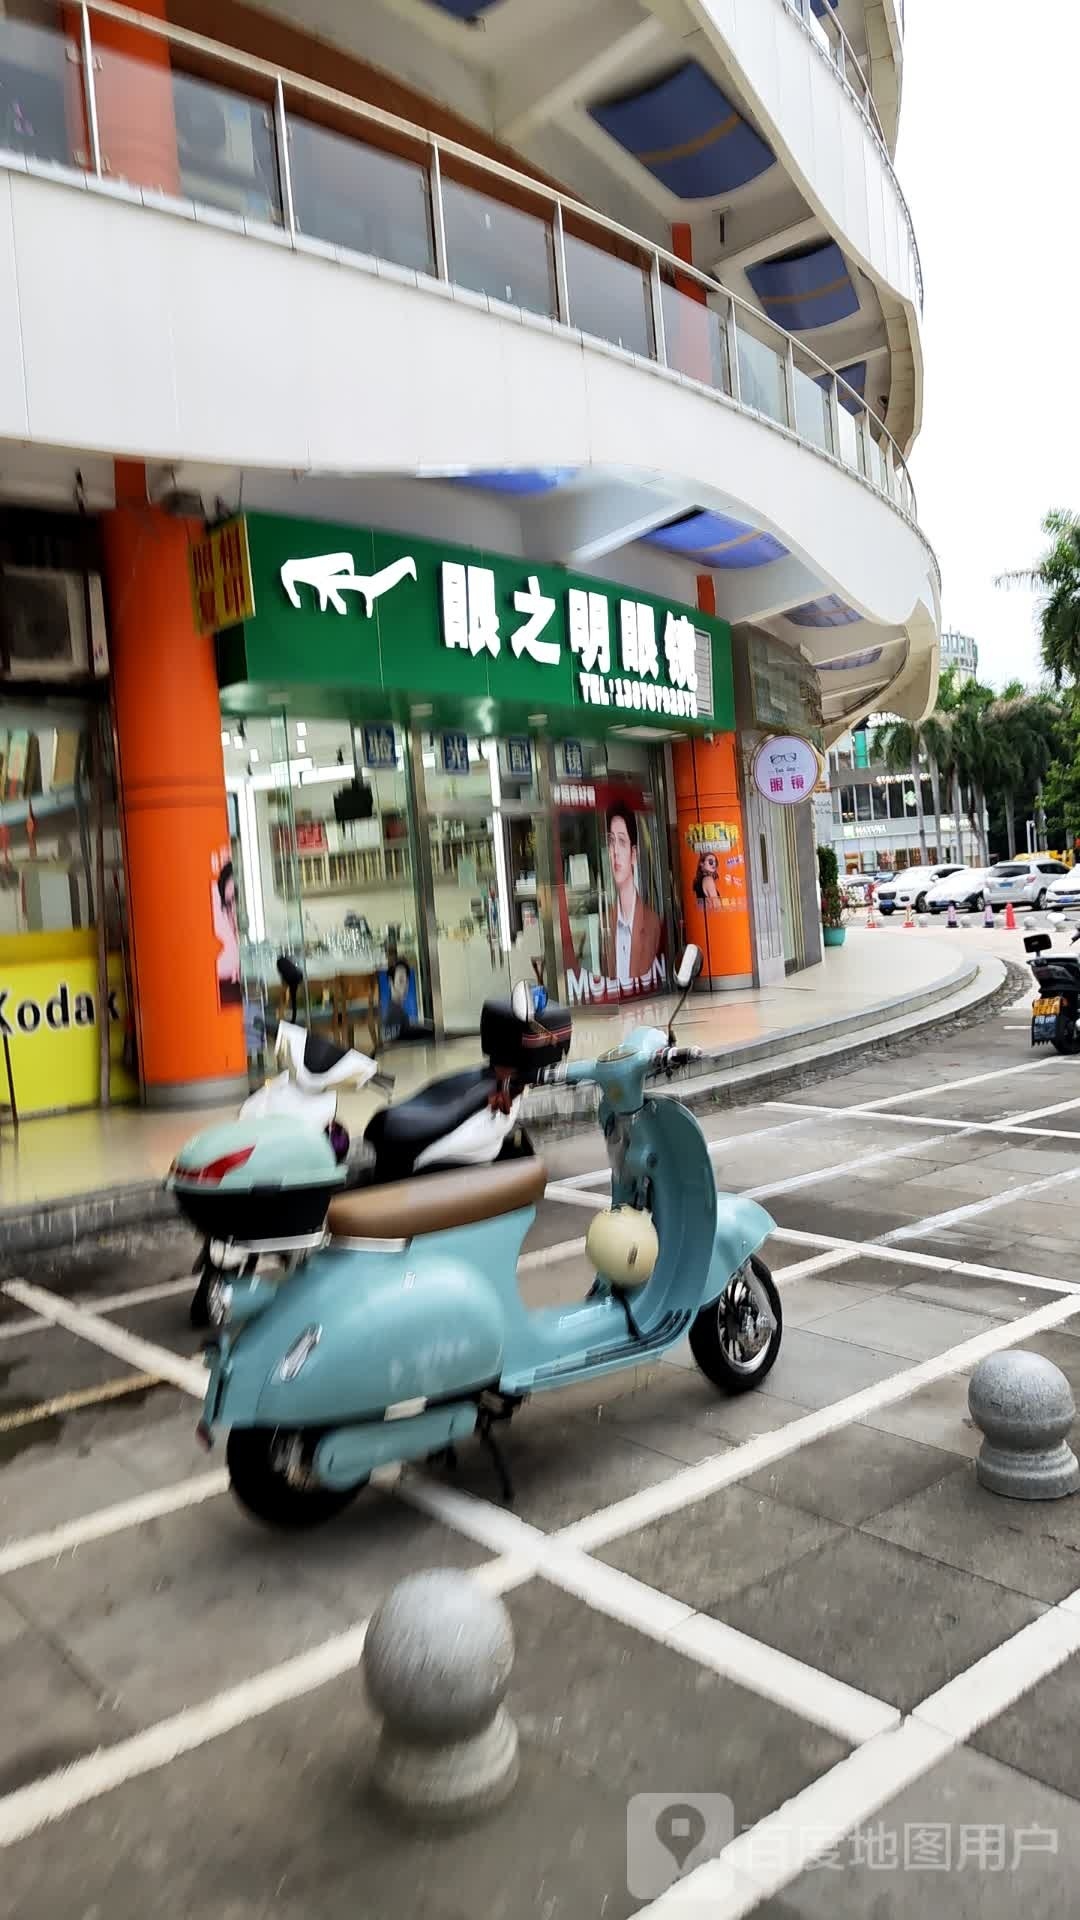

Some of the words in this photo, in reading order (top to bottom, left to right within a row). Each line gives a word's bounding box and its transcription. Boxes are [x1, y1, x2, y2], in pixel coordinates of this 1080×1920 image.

[441, 561, 698, 691] 眼之明眼镜
[770, 775, 804, 793] 眼镜
